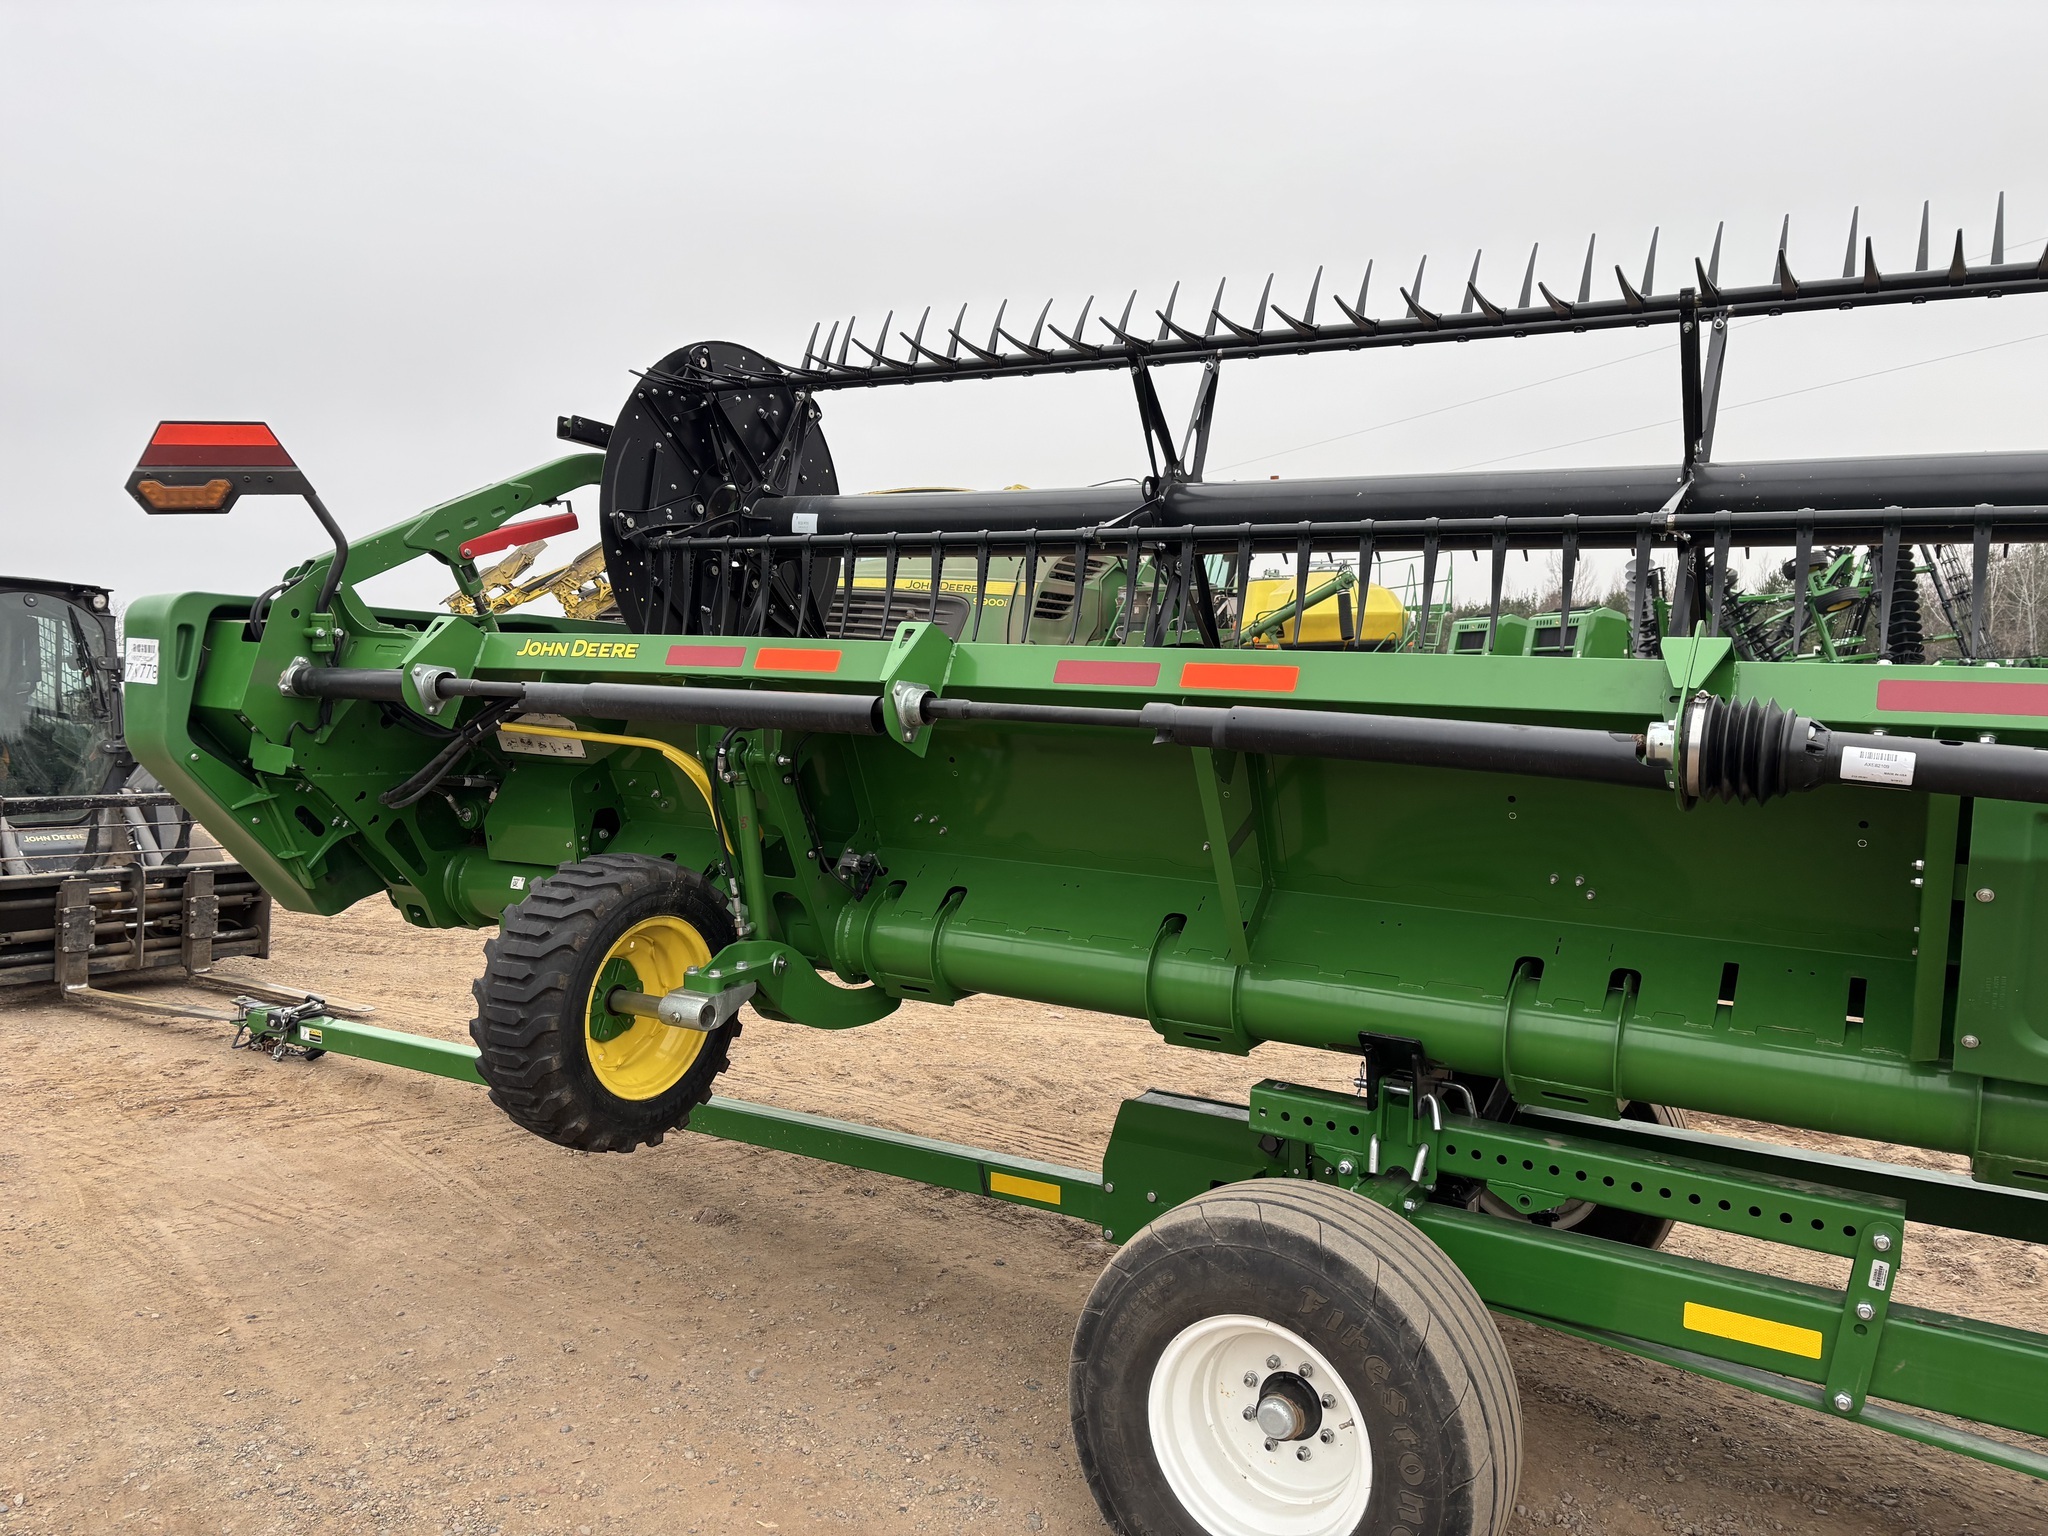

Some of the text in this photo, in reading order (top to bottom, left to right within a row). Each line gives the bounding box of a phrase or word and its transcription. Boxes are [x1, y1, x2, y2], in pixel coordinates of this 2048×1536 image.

[905, 580, 978, 593] JOH DEERE
[516, 638, 640, 658] JOHN DEERE
[24, 834, 51, 844] JOHN
